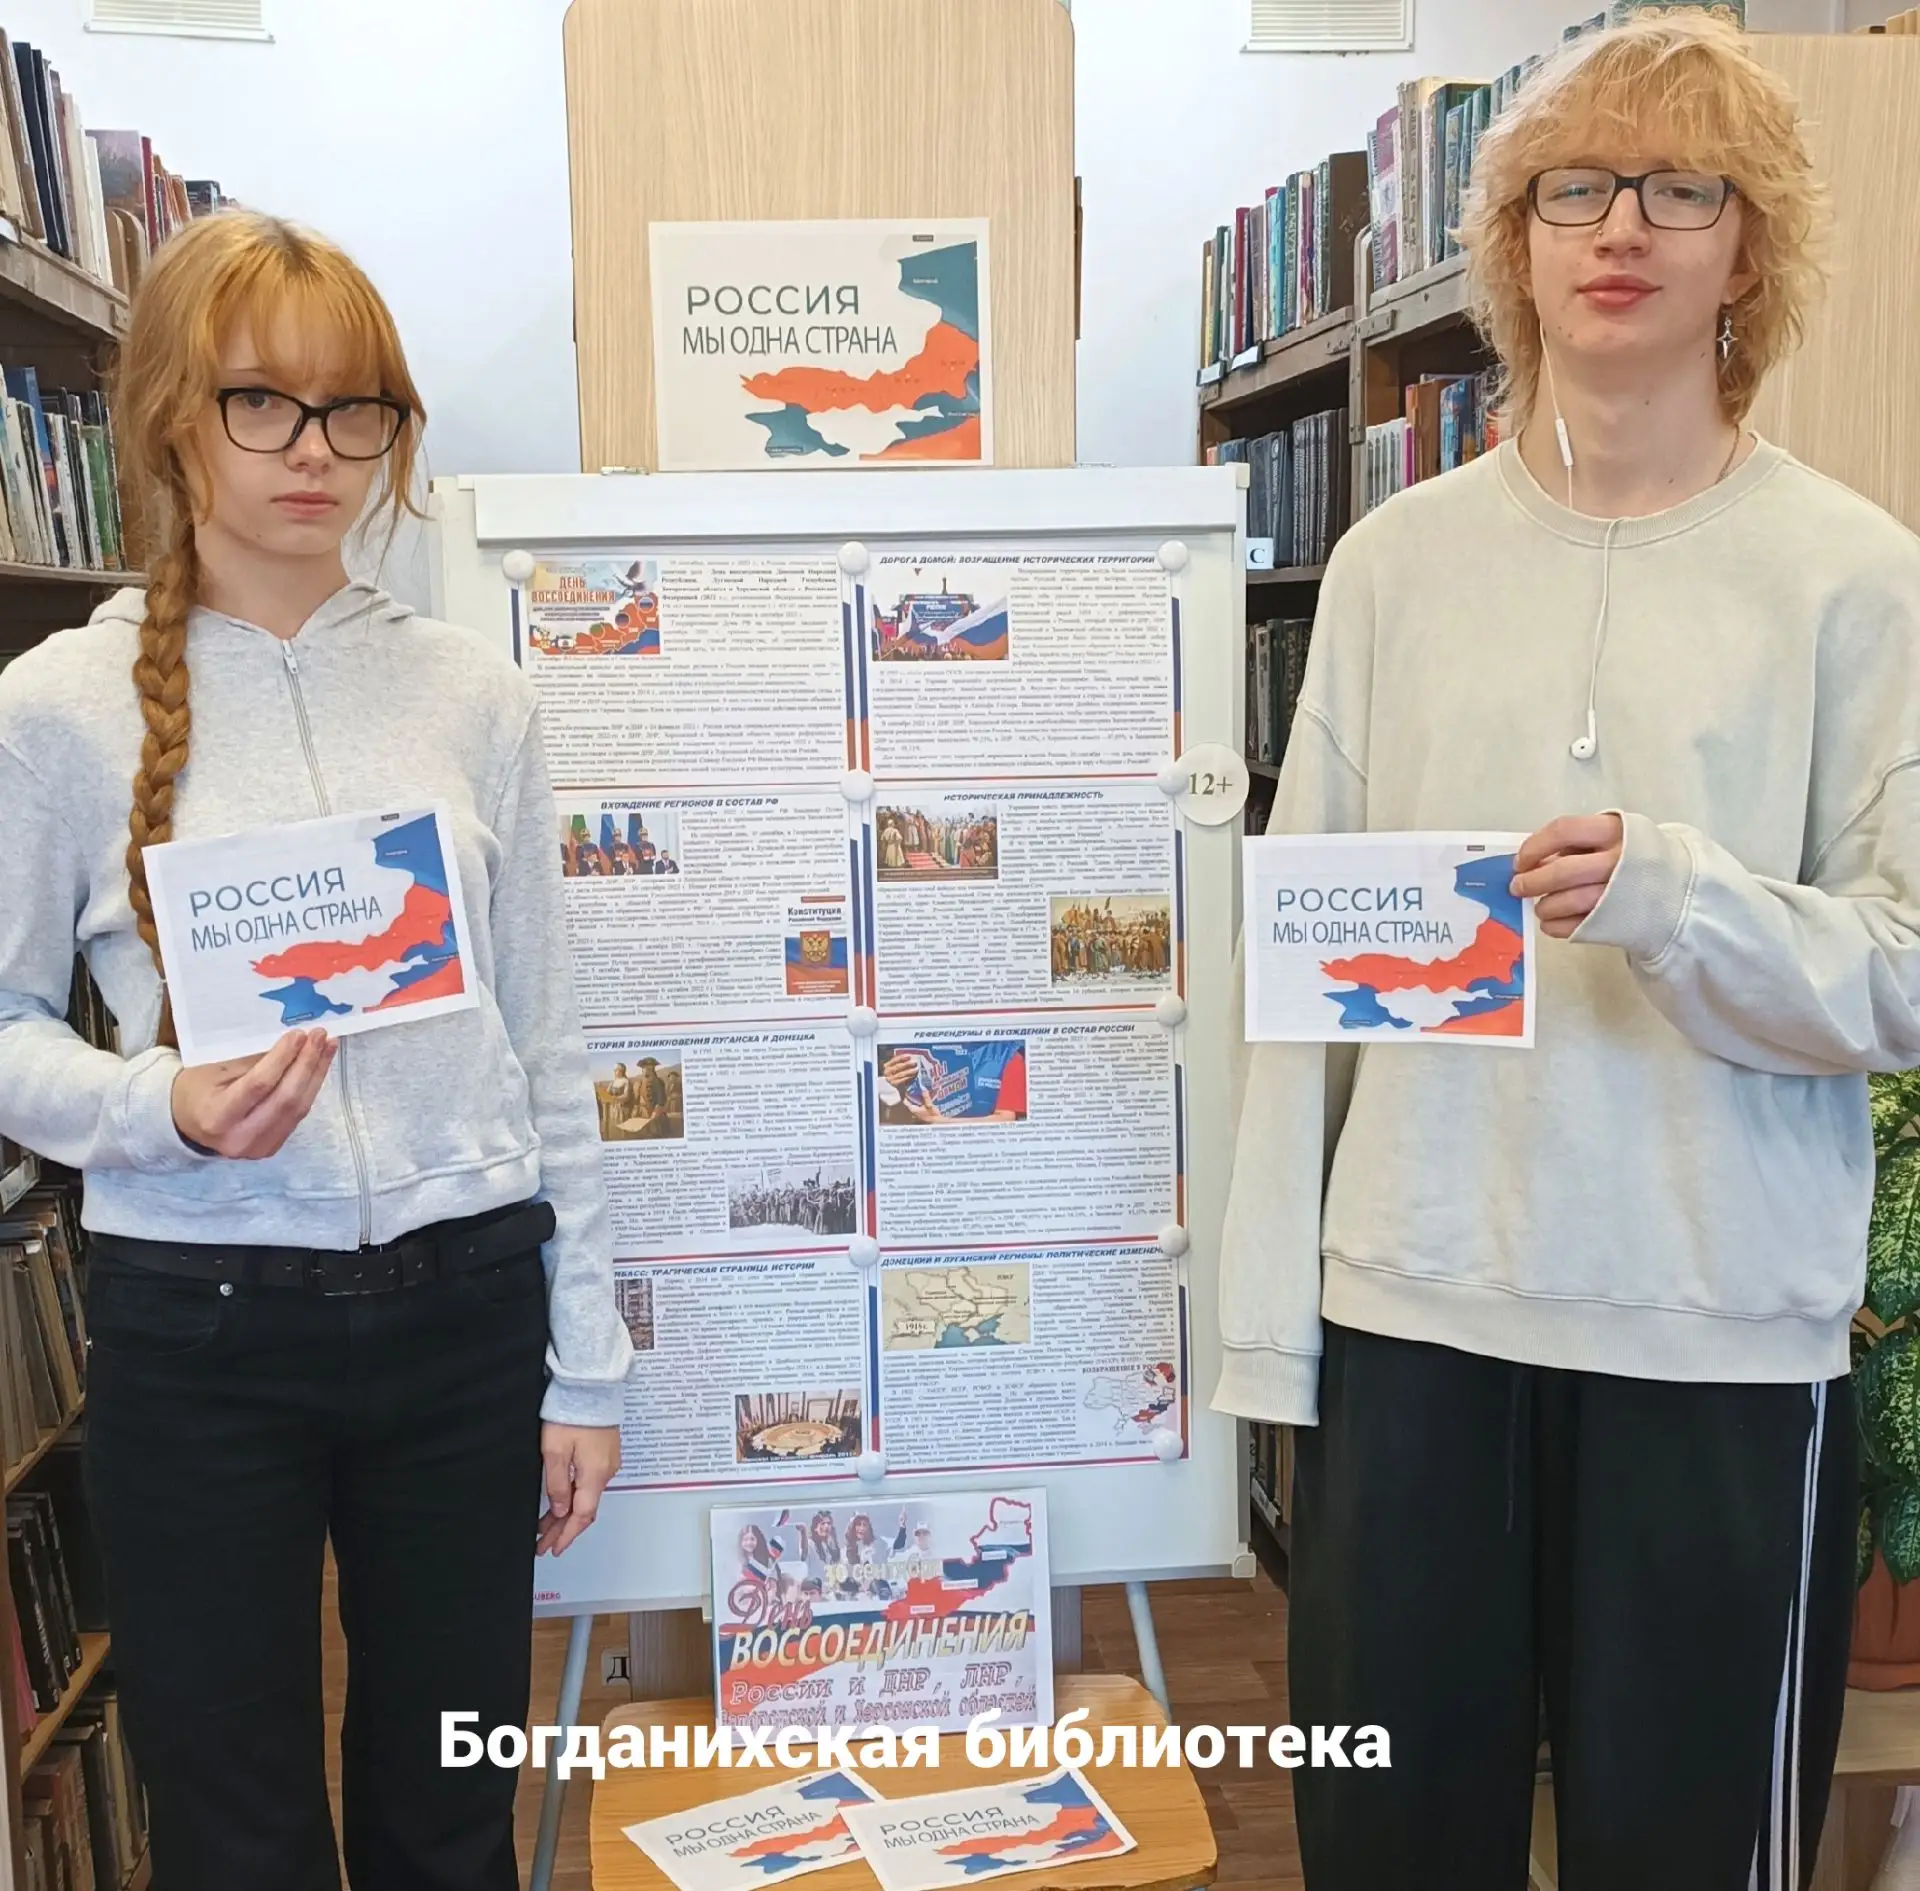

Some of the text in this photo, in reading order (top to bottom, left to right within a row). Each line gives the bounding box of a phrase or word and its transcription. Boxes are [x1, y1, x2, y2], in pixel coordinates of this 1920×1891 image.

[687, 285, 859, 315] РОССИЯ
[683, 326, 898, 356] МЫ ОДНА СТРАНА
[880, 556, 918, 564] ДОРОГА
[1023, 556, 1095, 564] ИСТОРИЧЕСКИХ
[560, 576, 586, 590] ДЕНЬ
[531, 590, 616, 604] ВОССОЕДИНЕНИЯ
[944, 791, 1104, 801] ИСТОРИЧЕСКАЯ ПРИНАДЛЕЖНОСТЬ
[1188, 772, 1233, 796] 12+
[601, 797, 779, 810] ВХОЖДЕНИЕ РЕГИОНОВ В СОСТАВ РФ
[189, 867, 346, 918] РОССИЯ
[1277, 886, 1424, 912] РОССИЯ
[191, 895, 383, 952] МЫ ОДНА СТРАНА
[1273, 921, 1454, 946] МЫ ОДНА СТРАНА
[586, 1033, 815, 1050] СТОРИЯ ВОЗНИКНОВЕНИЯ ЛУГАНСКА И ДОНЕЦКА
[914, 1030, 983, 1038] РЕФЕРЕНДУМЫ
[1053, 1026, 1060, 1035] В
[1061, 1026, 1097, 1035] СОСТАВ
[1098, 1024, 1136, 1034] РОССИИ
[1046, 1248, 1117, 1259] ПОЛИТИЧЕСКИЕ
[614, 1262, 815, 1278] НБАСС: ТРАГИЧЕСКАЯ СТРАНИЦА ИСТОРИИ
[824, 1564, 848, 1585] 30
[728, 1579, 813, 1631] День
[729, 1608, 1030, 1671] ВОССОЕДИНЕНИЯ
[606, 1656, 632, 1684] Д
[731, 1678, 834, 1705] России
[848, 1676, 866, 1696] и
[665, 1805, 786, 1846] РОССИЯ
[672, 1810, 824, 1858] МЫ ОДНА СТРАНА
[880, 1806, 1003, 1836] РОССИЯ
[882, 1813, 1040, 1849] МЫ ОДНА СТРАНА
